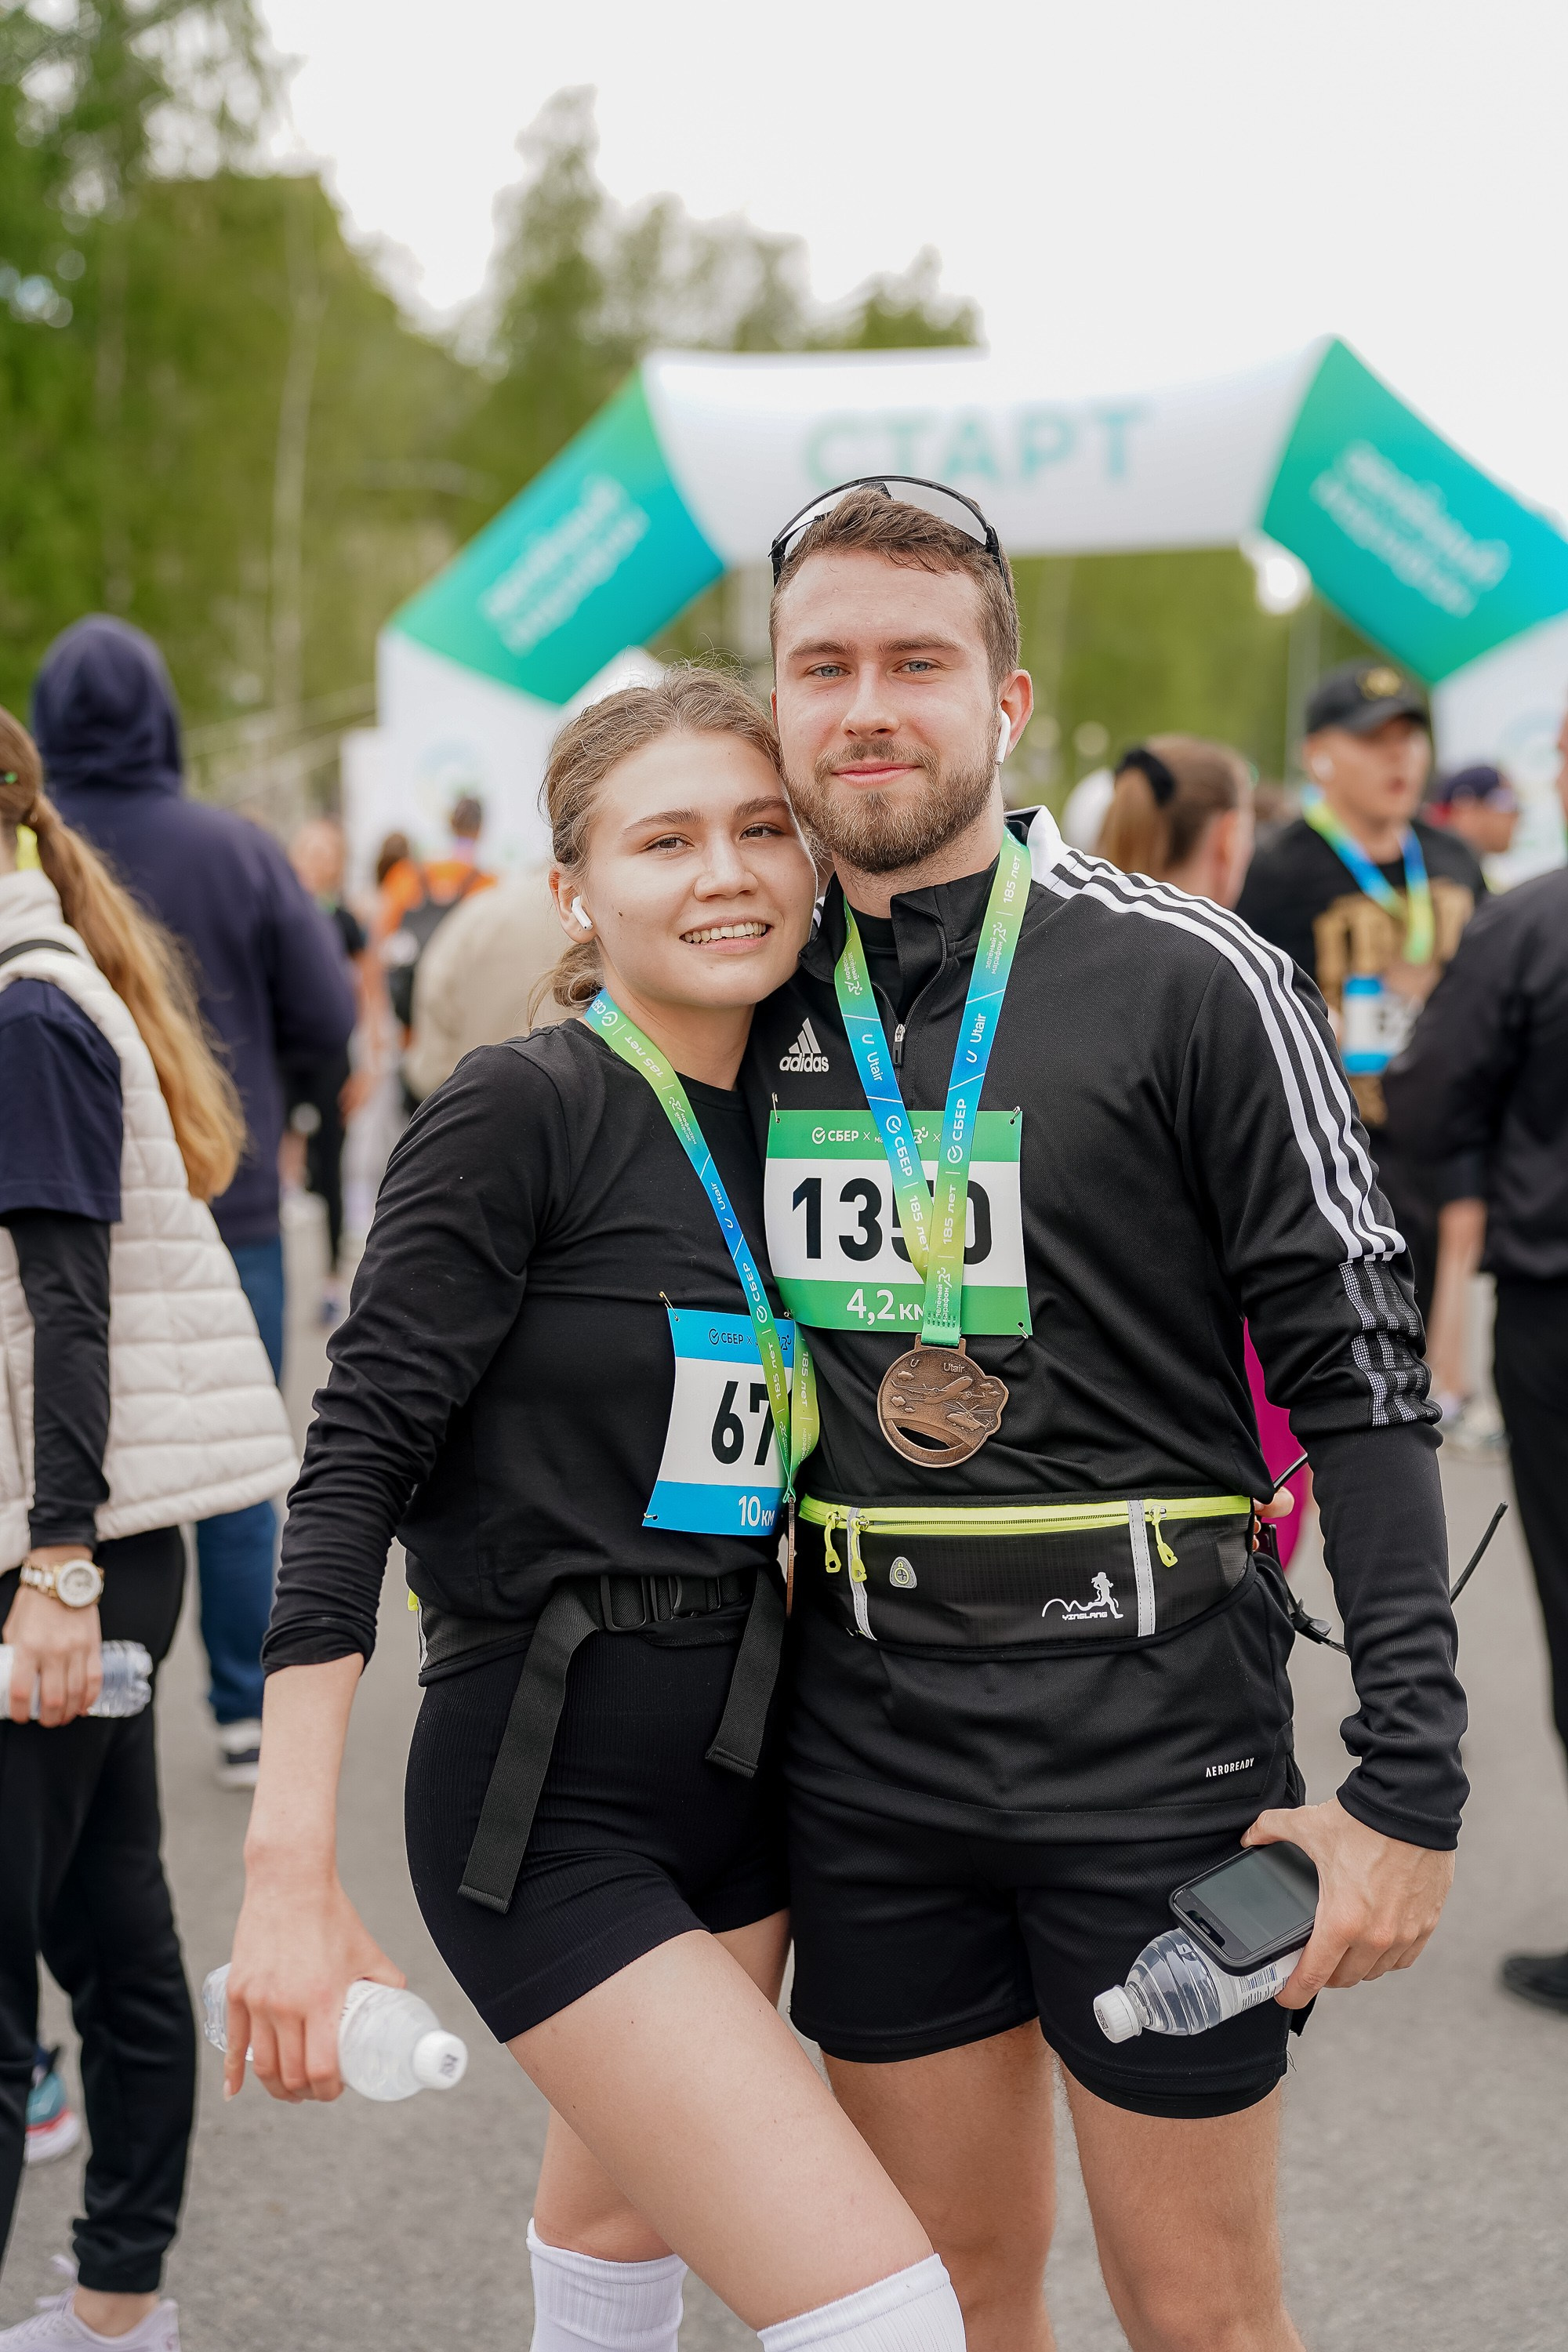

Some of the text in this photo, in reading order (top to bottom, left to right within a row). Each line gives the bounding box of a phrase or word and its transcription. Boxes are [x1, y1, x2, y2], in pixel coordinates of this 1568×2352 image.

[804, 398, 1149, 489] СТАРТ
[1004, 855, 1021, 903] 185 лет
[985, 937, 997, 969] зелёный
[992, 941, 1004, 975] марафон
[970, 1013, 986, 1043] Utair
[624, 1036, 664, 1078] 185 лет
[779, 1053, 829, 1073] adidas
[866, 1051, 883, 1081] Utair
[681, 1112, 697, 1145] марафон
[828, 1130, 859, 1142] СБЕР
[895, 1136, 913, 1177] СБЕР
[909, 1195, 924, 1222] 185
[943, 1098, 967, 1245] СБЕР 185 лет
[710, 1181, 726, 1210] Utair
[720, 1332, 744, 1345] СБЕР
[742, 1262, 782, 1400] СБЕР 185 лет
[943, 1363, 966, 1374] Utair
[1206, 1758, 1254, 1778] AEROREADY
